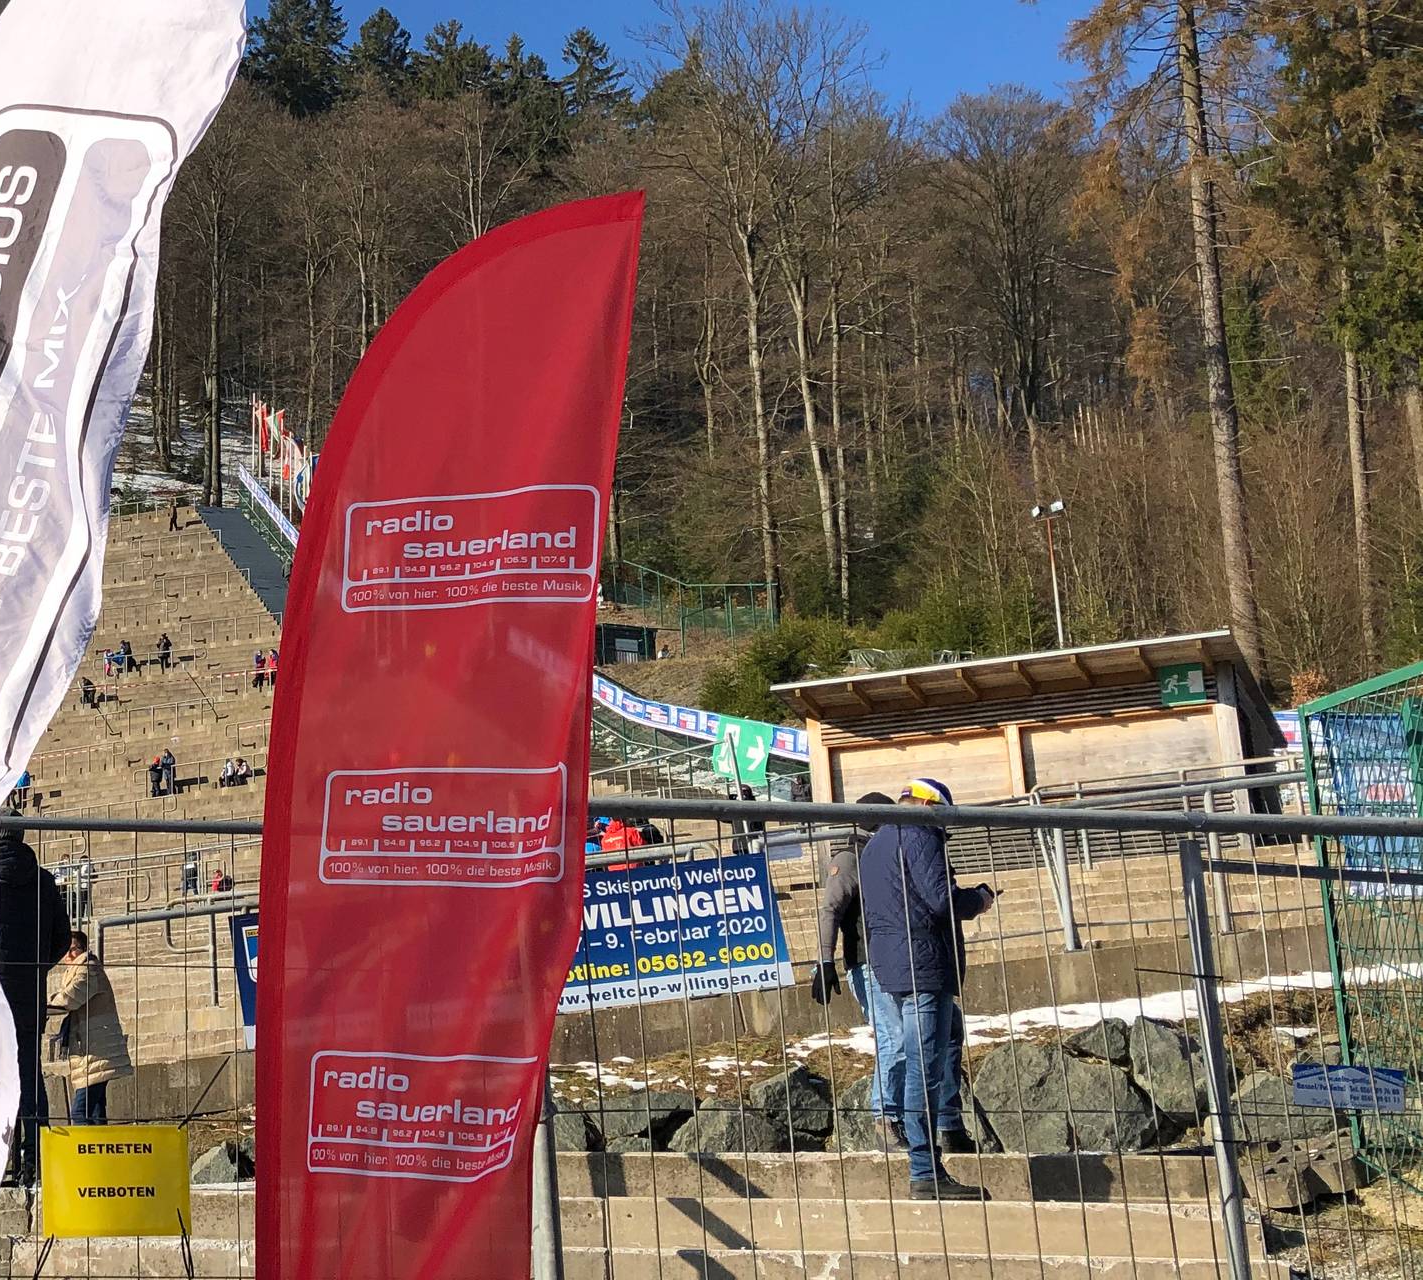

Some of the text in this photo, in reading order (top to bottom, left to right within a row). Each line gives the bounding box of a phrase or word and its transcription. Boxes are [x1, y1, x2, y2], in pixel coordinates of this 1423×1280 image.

[365, 509, 454, 536] radio
[403, 526, 577, 559] sauerland
[351, 579, 586, 602] 100% von hier. 100% die beste Musik.
[344, 781, 433, 805] radio
[381, 806, 553, 833] sauerland
[328, 862, 364, 873] 100%
[367, 865, 389, 874] von
[393, 864, 419, 874] hier.
[425, 863, 463, 875] 100%
[466, 865, 485, 876] die
[489, 865, 522, 877] beste
[596, 875, 682, 897] Skisprung
[685, 866, 757, 886] Weltcup
[631, 925, 712, 945] Februar
[718, 916, 767, 936] 2020
[566, 942, 774, 982] otline: 05632-9600
[323, 1066, 410, 1092] radio
[355, 1098, 522, 1126] sauerland
[77, 1142, 153, 1155] BETRETEN
[339, 1152, 359, 1162] von
[396, 1154, 427, 1166] 100%
[431, 1156, 451, 1169] die
[77, 1186, 155, 1198] VERBOTEN
